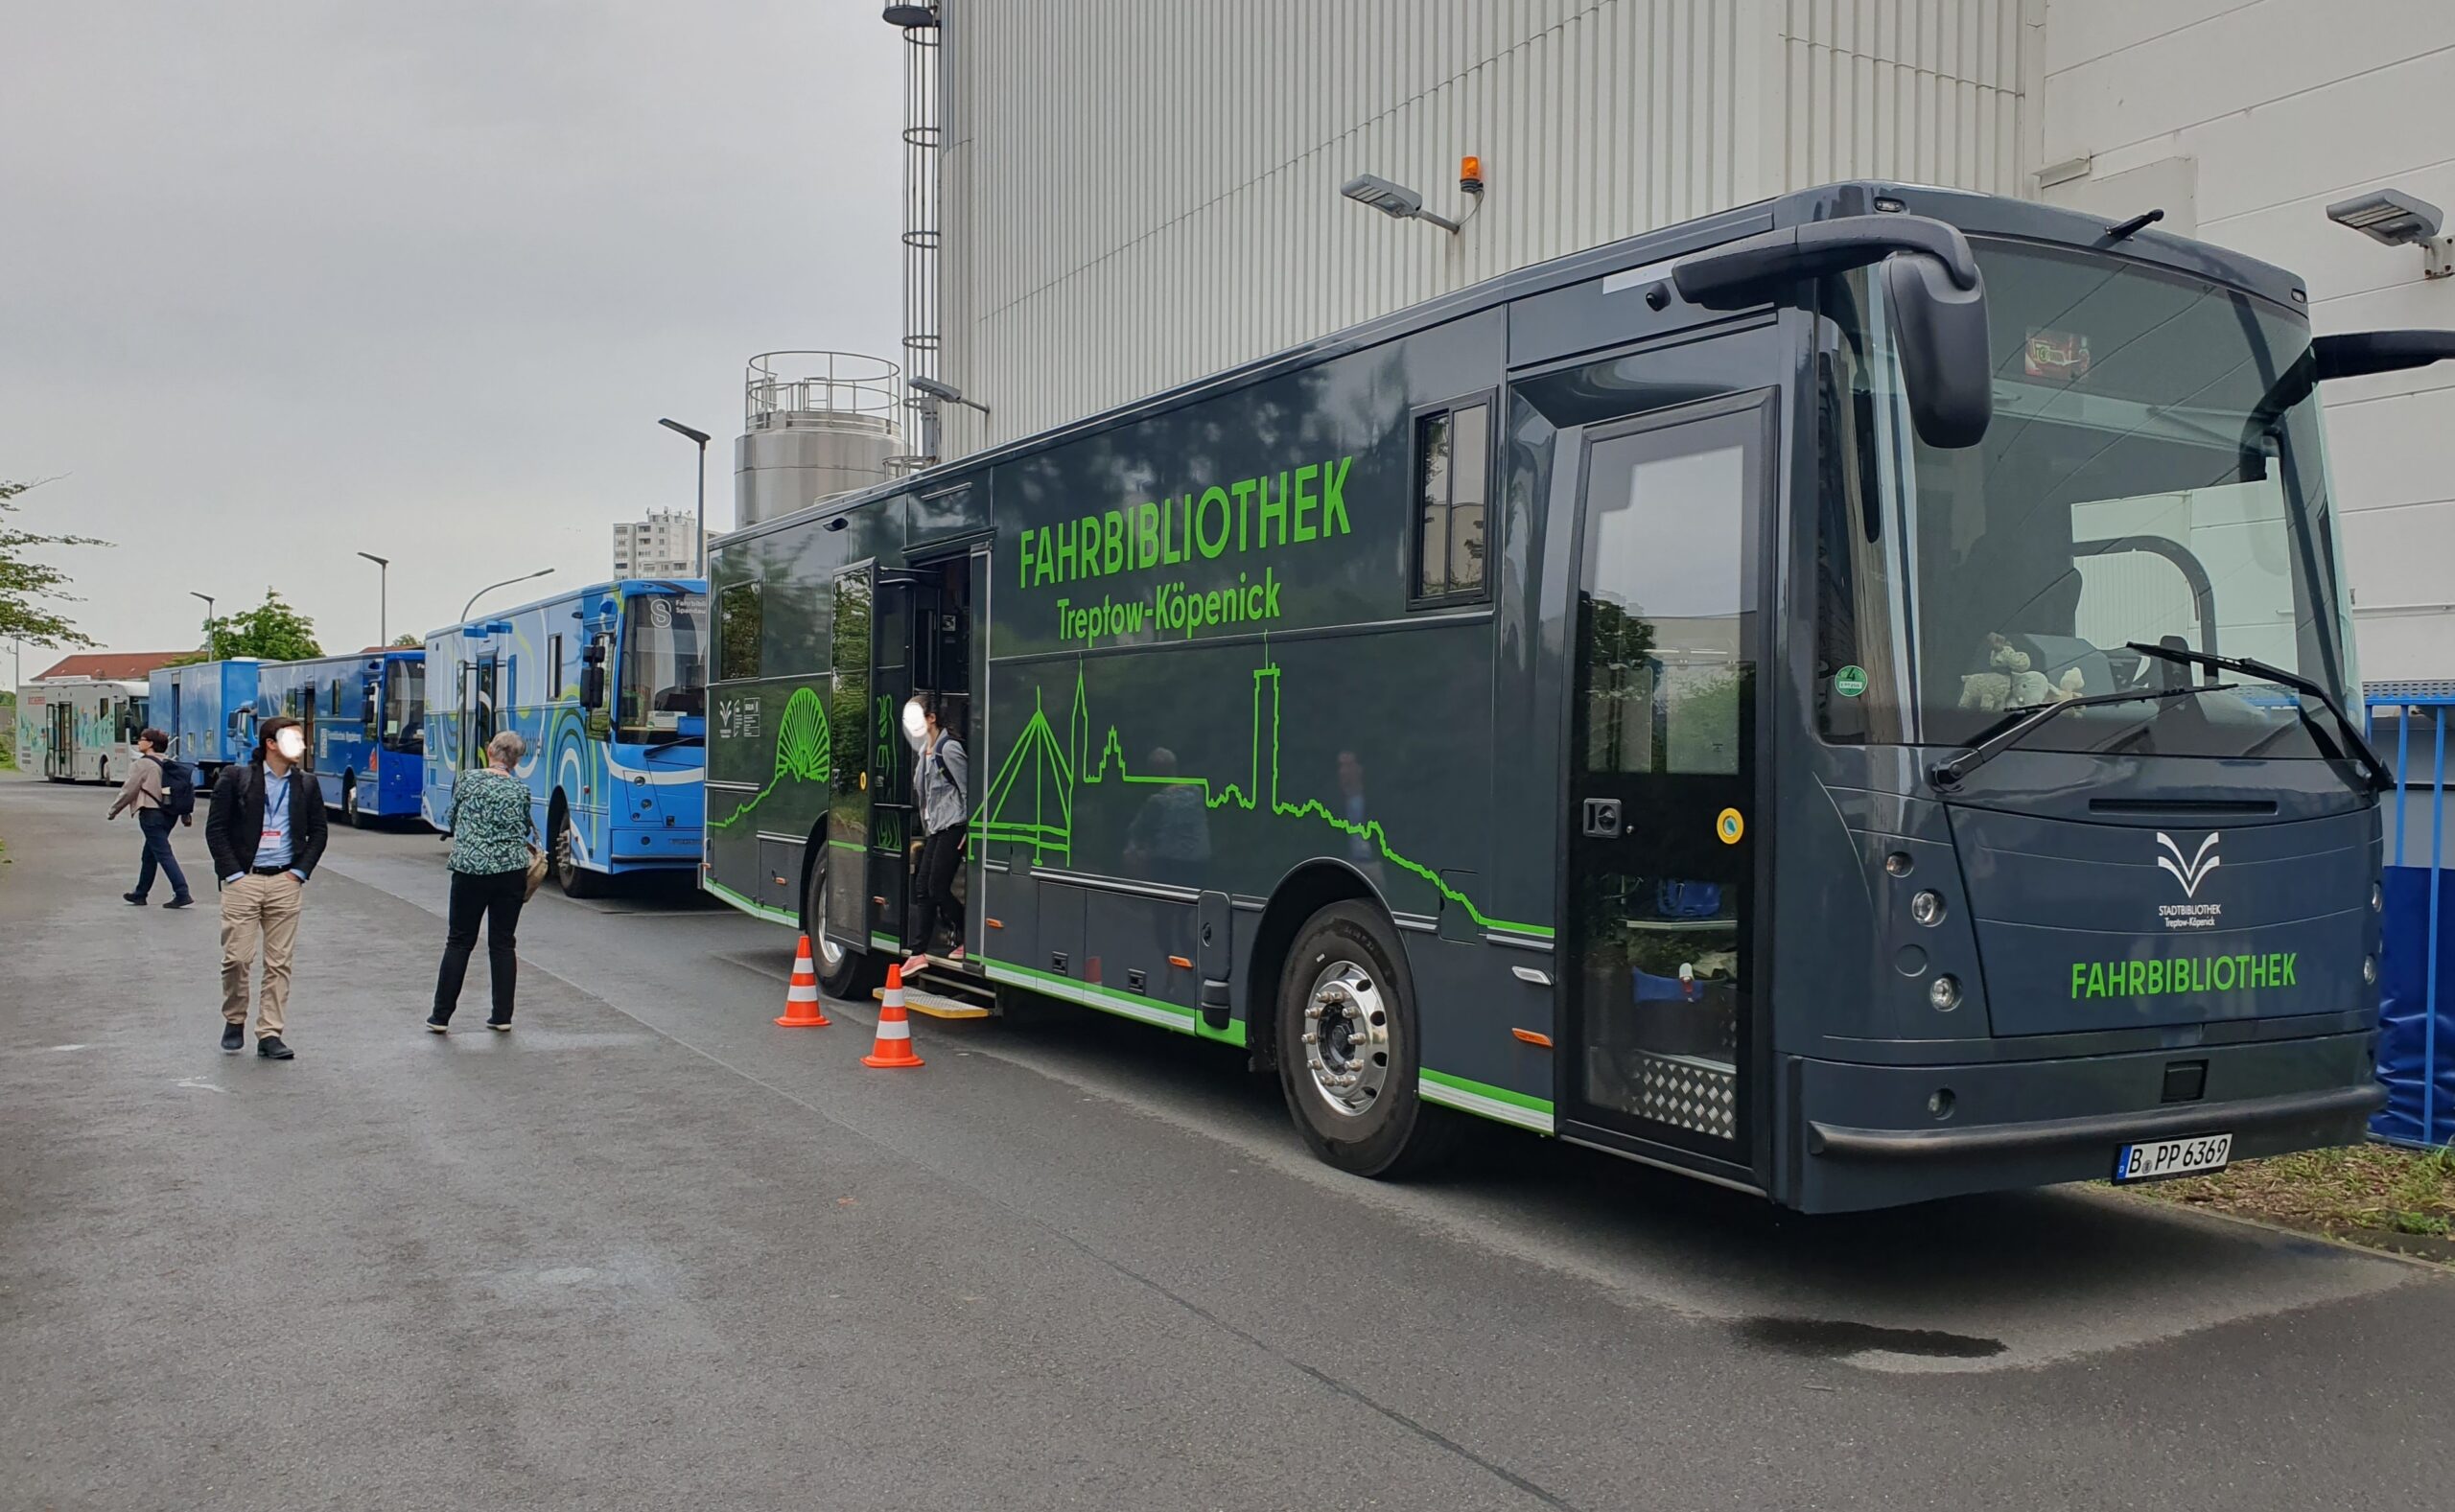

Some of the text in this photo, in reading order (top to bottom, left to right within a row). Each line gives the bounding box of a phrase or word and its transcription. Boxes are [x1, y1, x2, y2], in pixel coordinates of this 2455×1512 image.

[1020, 455, 1352, 589] FAHRBIBLIOTHEK
[1057, 567, 1281, 648] Treptow-Köpenick
[1846, 667, 1856, 682] 4
[2159, 904, 2222, 916] STADTBIBLIOTHEK
[2164, 916, 2215, 929] Treptow-Köpenick
[2071, 952, 2298, 999] FAHRBIBLIOTHEK
[2128, 1148, 2143, 1175] B
[2154, 1144, 2181, 1171] PP
[2183, 1138, 2229, 1167] 6369
